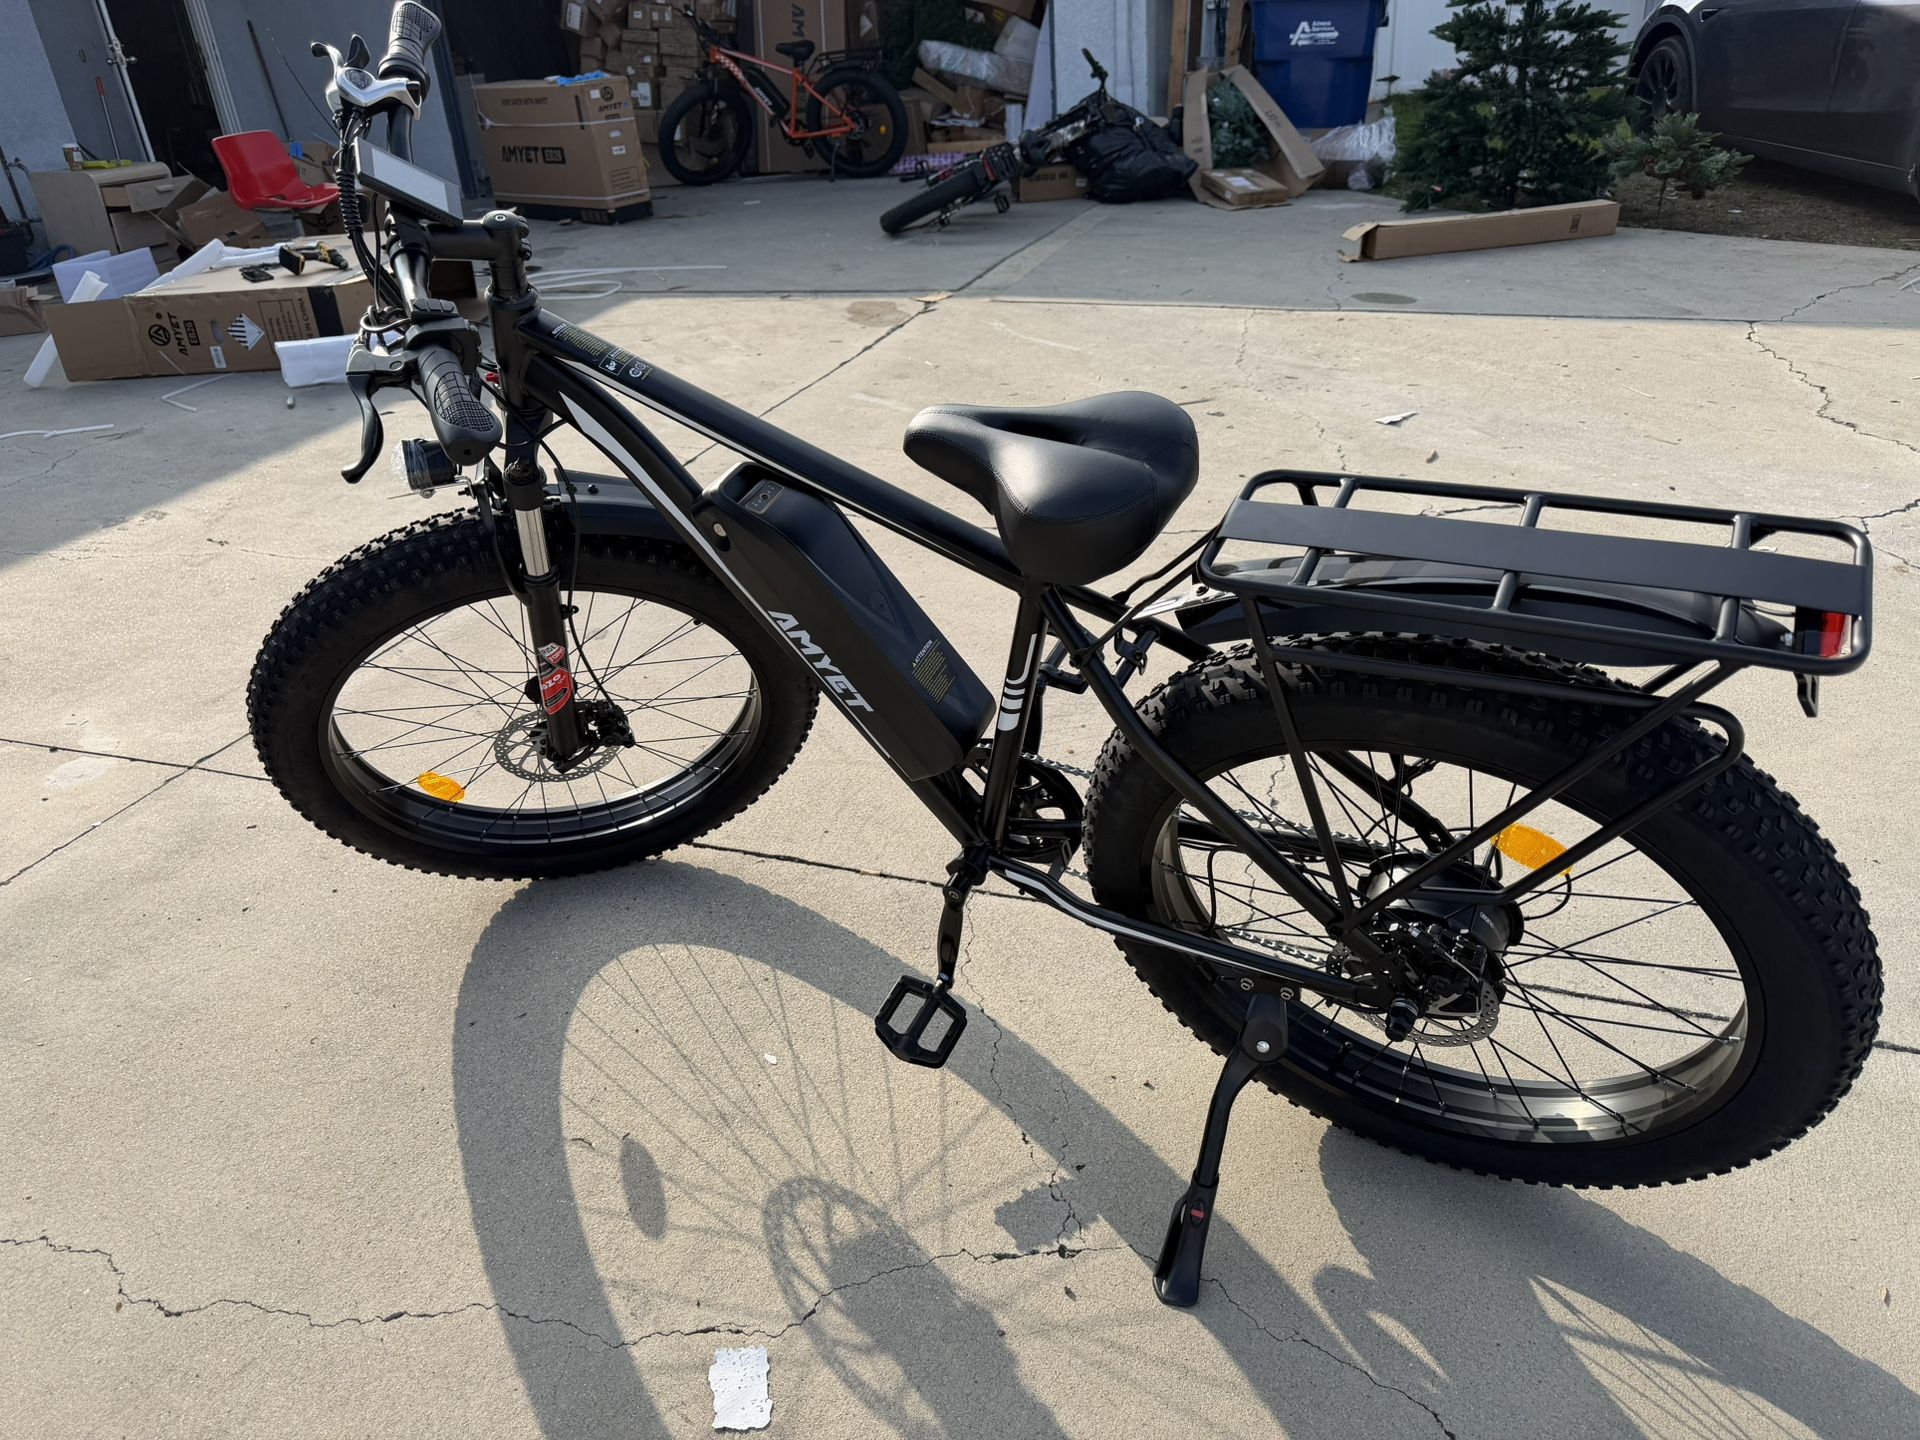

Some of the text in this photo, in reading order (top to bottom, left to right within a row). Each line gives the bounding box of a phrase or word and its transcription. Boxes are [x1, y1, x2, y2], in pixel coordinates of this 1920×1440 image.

[502, 146, 539, 164] AMYET
[297, 297, 310, 322] CHINA
[167, 312, 189, 357] AMYET
[767, 610, 875, 712] AMYET
[914, 639, 933, 664] ATTENTION
[542, 673, 562, 690] OZO
